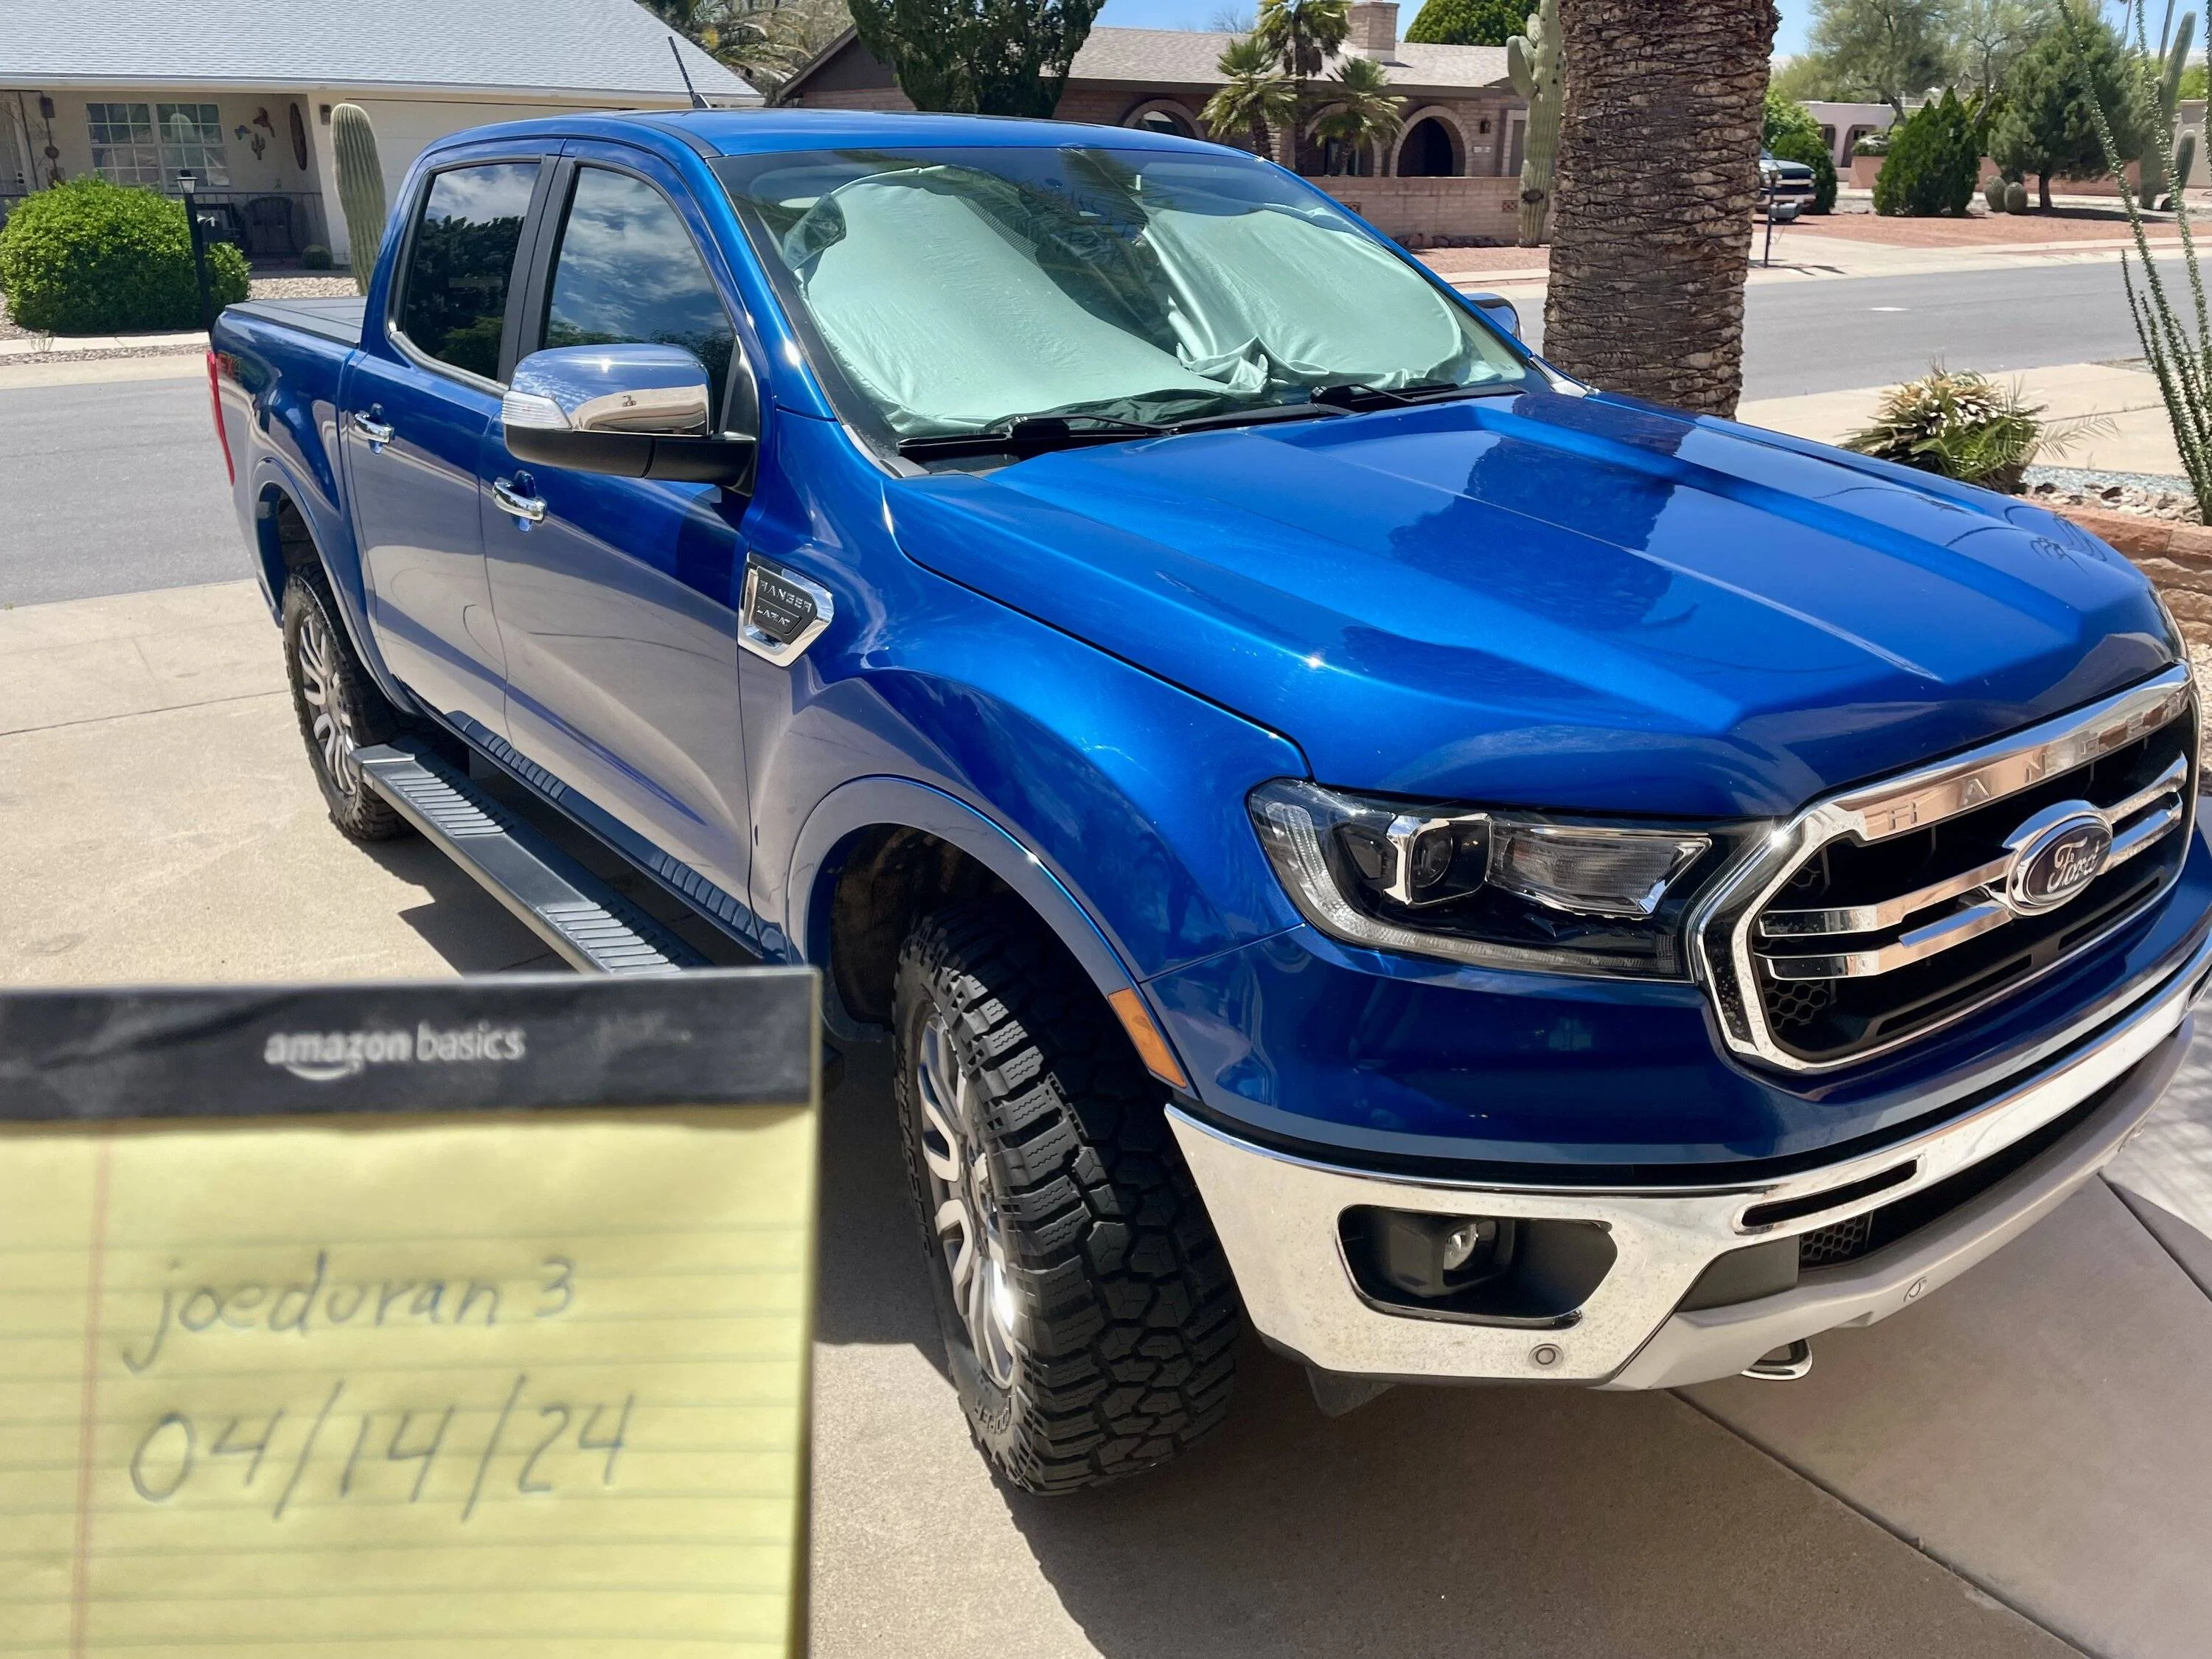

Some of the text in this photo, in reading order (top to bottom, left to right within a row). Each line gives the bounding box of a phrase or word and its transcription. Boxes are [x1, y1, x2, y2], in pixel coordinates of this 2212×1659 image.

[2047, 835, 2100, 894] Ford
[263, 1018, 527, 1064] amazon basics
[534, 1255, 575, 1319] 3
[130, 1373, 636, 1523] 04/14/24
